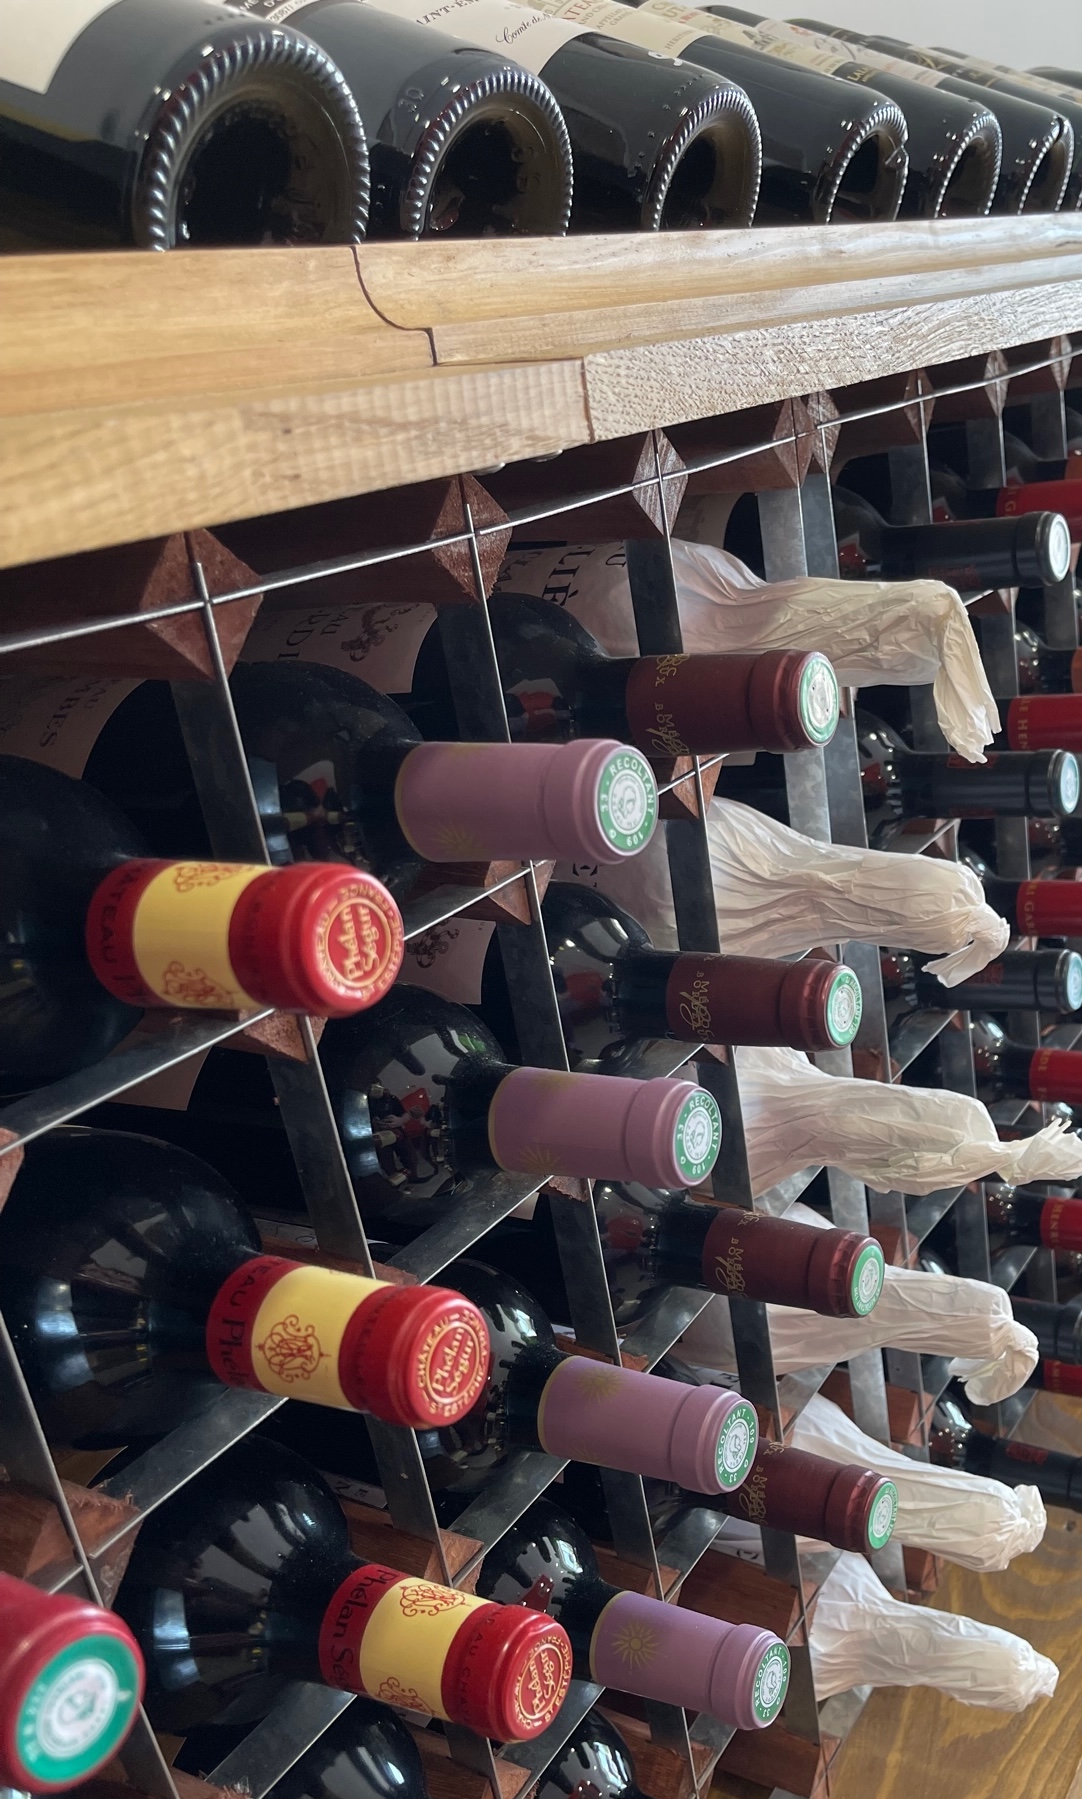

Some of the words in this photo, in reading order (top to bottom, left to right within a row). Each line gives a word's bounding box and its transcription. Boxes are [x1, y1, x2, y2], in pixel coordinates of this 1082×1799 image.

[496, 19, 531, 44] Comte
[600, 793, 609, 813] 33
[609, 757, 655, 816] RECOLTANT
[625, 831, 644, 847] 109
[336, 904, 364, 981] Phélan
[357, 903, 380, 972] Ségur
[677, 1125, 684, 1141] 33
[689, 1096, 720, 1151] RECOLTANT
[692, 1162, 706, 1175] 109
[431, 1326, 465, 1392] Phélan
[444, 1336, 474, 1396] Ségur
[717, 1408, 747, 1475] RECOLTANT
[748, 1421, 756, 1444] 109
[729, 1472, 738, 1484] 33
[332, 1569, 400, 1639] Phélan
[528, 1660, 546, 1715] Phélan
[539, 1650, 557, 1699] Ségur
[754, 1646, 782, 1708] RECOLTANT
[762, 1708, 771, 1718] 33
